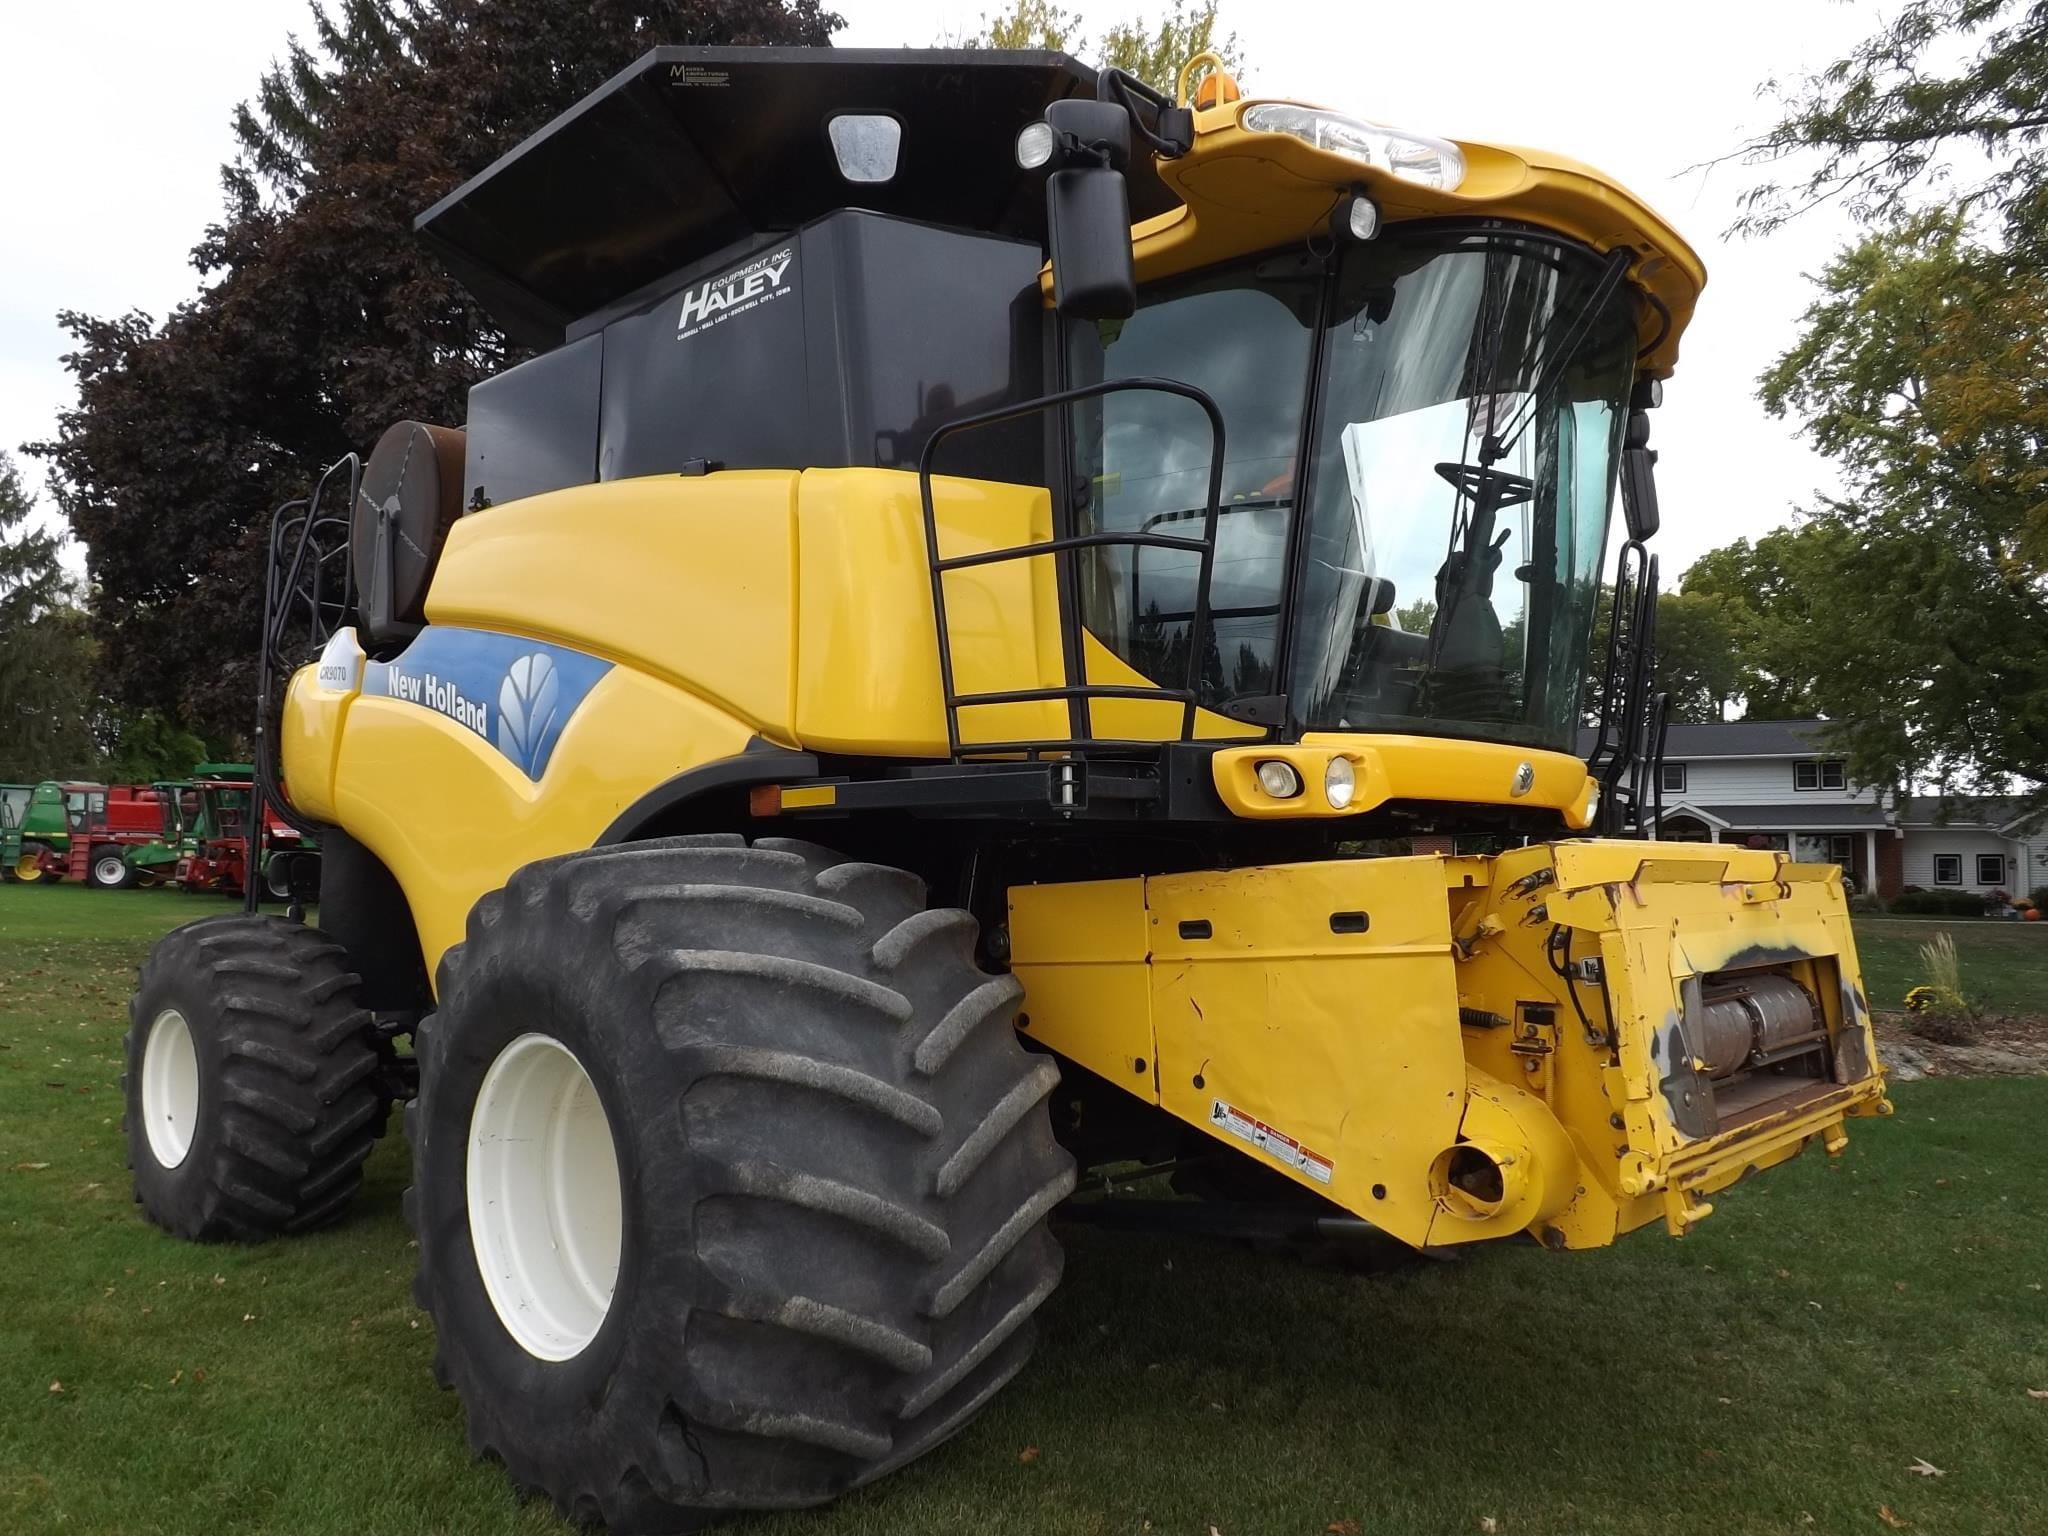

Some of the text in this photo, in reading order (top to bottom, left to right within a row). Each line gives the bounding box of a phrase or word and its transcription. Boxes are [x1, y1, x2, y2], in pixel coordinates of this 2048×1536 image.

[711, 248, 792, 290] EQUIPMENT INC.
[678, 258, 791, 330] HALEY
[701, 320, 714, 330] WALL
[775, 286, 791, 297] IOWA
[320, 666, 347, 681] CR9070
[388, 665, 487, 738] New Holland
